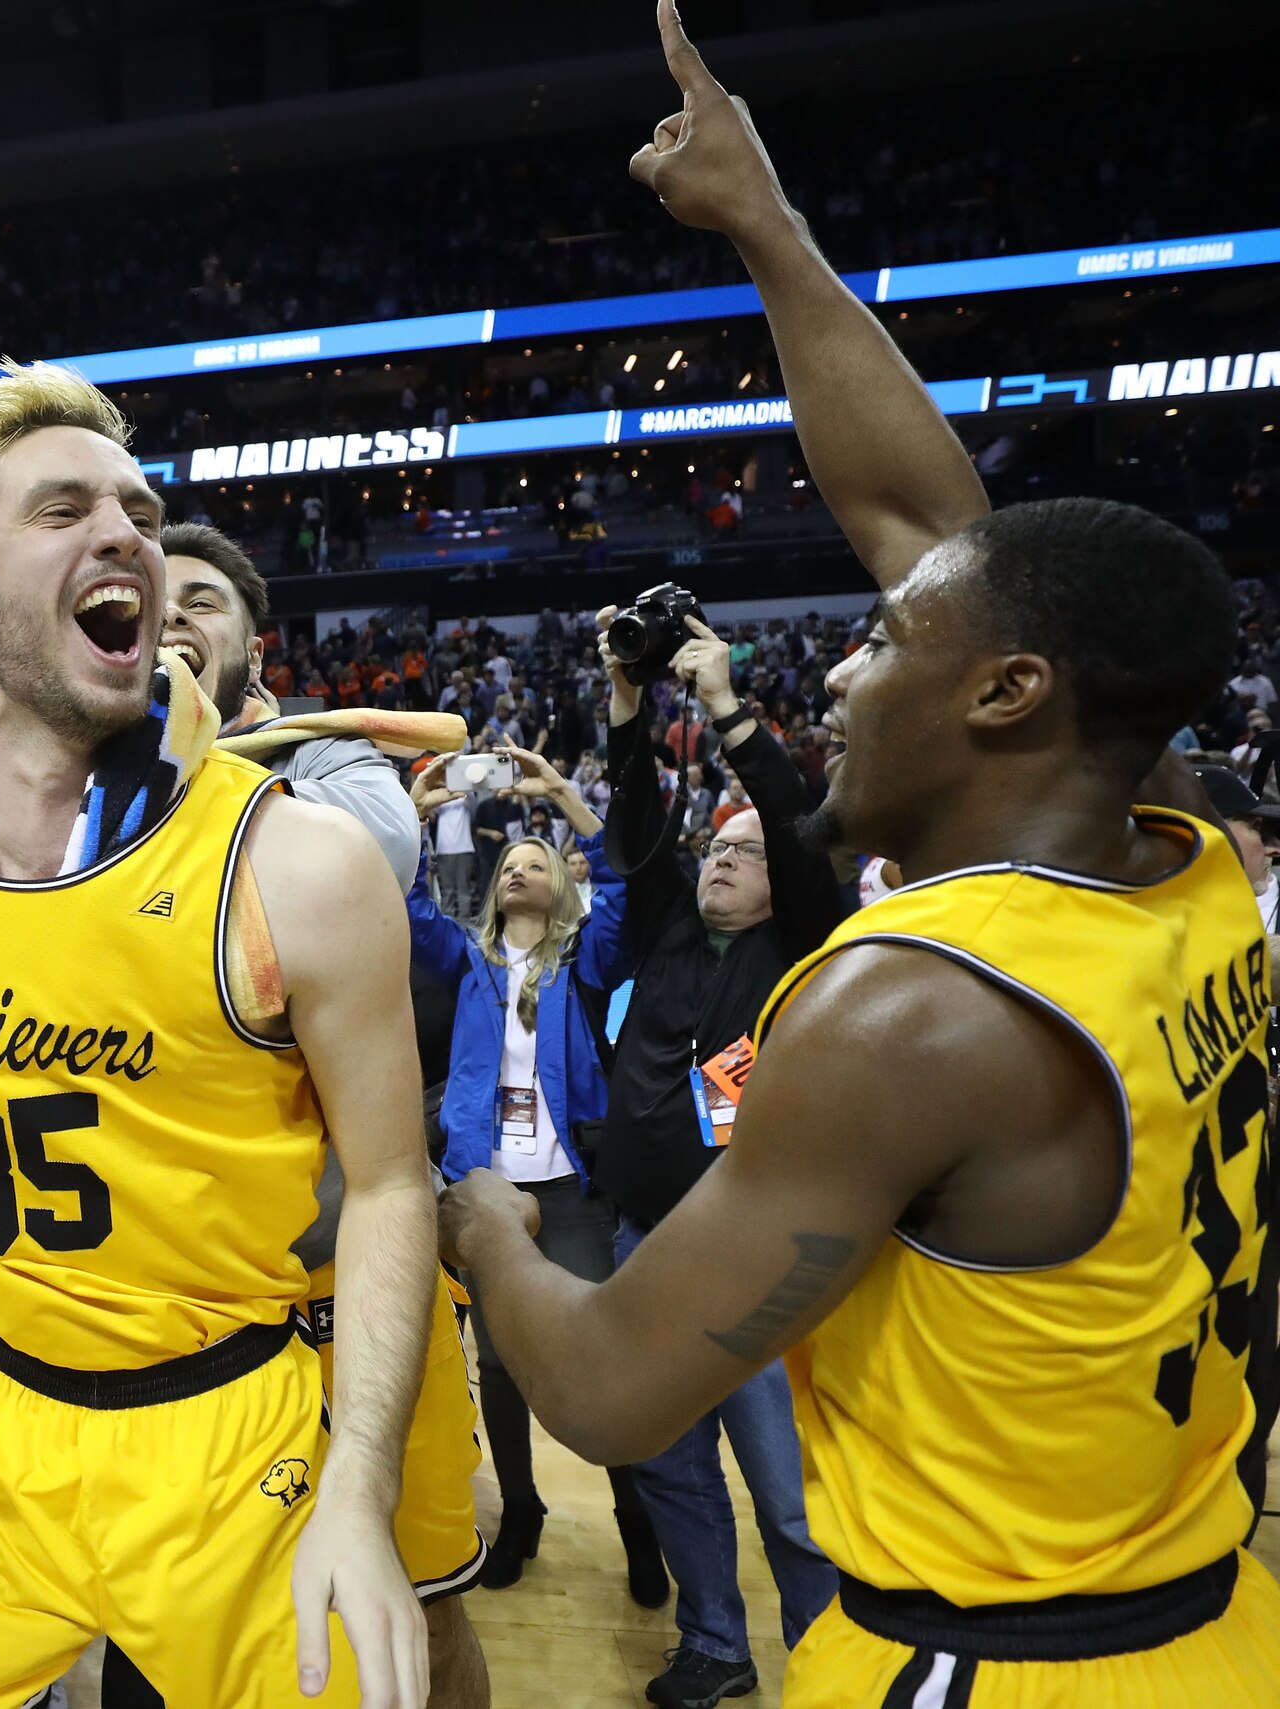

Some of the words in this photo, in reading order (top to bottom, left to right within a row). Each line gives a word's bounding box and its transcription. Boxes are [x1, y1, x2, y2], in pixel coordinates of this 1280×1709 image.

[1077, 252, 1129, 275] UMBC
[1131, 249, 1155, 270] VS
[1158, 241, 1234, 267] VIRGINIA
[1157, 937, 1270, 1103] LAMAR
